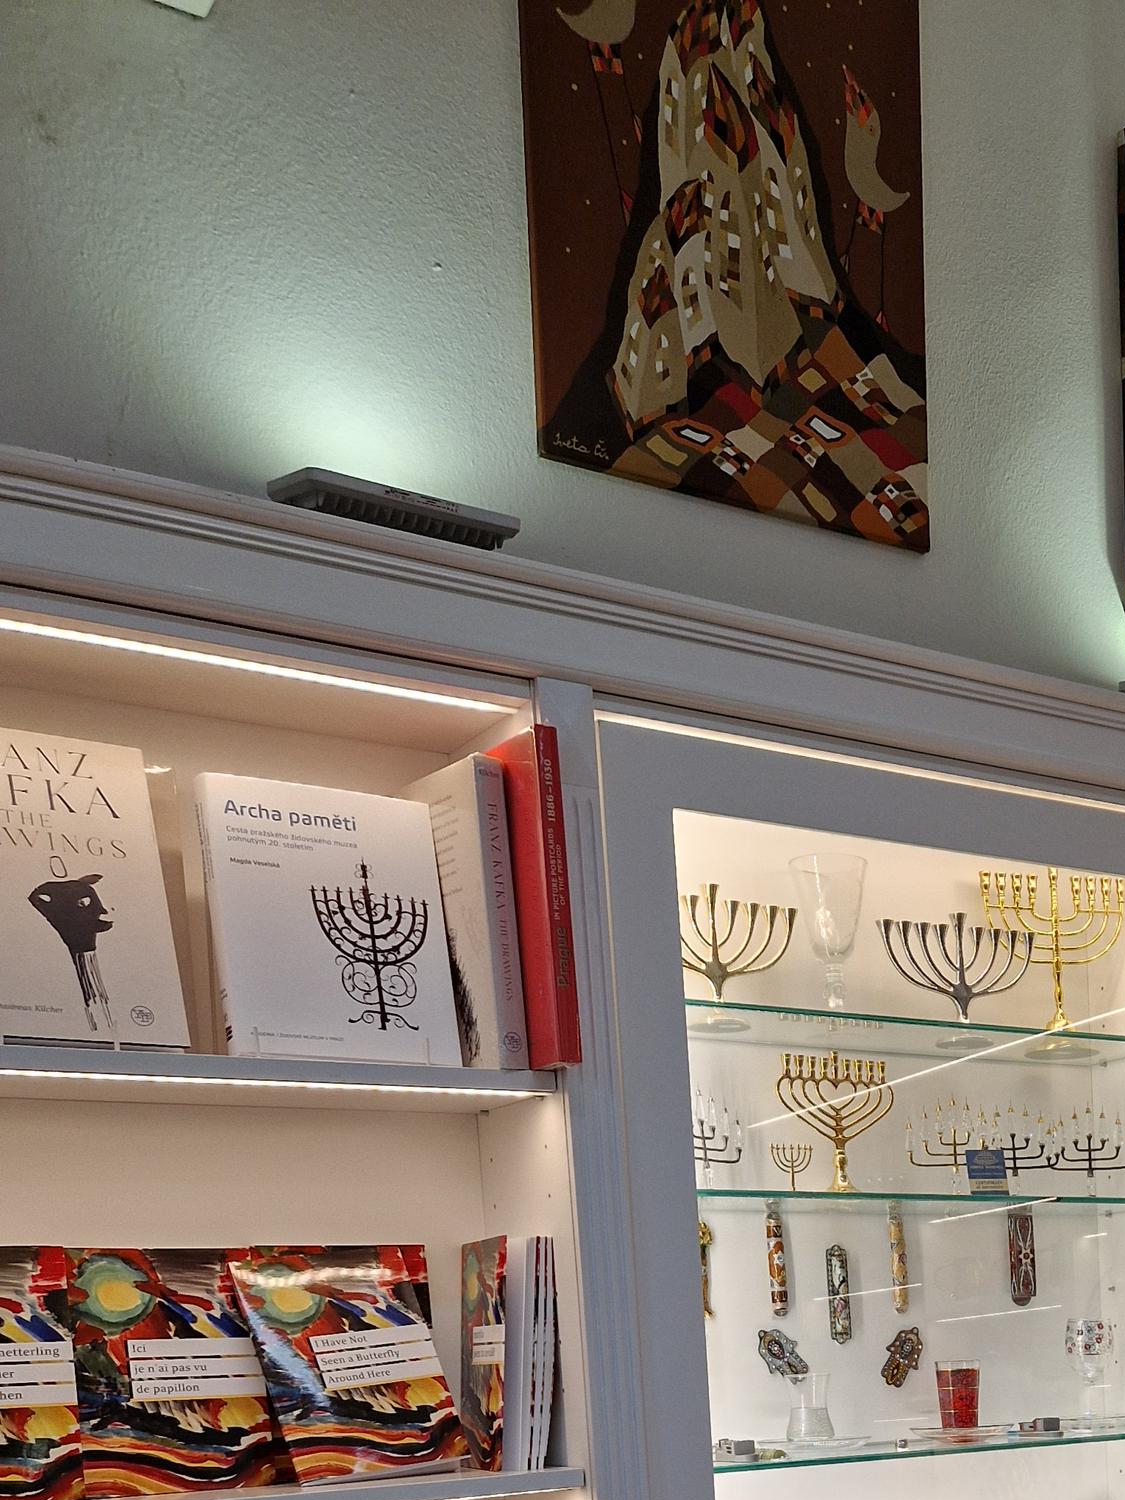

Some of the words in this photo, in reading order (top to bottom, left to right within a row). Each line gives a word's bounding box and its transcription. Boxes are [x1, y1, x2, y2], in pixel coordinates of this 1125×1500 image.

[0, 808, 52, 829] THE
[224, 799, 282, 822] Archa
[289, 811, 357, 832] paměti
[0, 826, 127, 860] WINGS
[555, 927, 570, 988] Prague
[132, 1344, 146, 1353] Ici
[322, 1337, 347, 1347] Have
[350, 1335, 367, 1345] Not
[321, 1356, 345, 1366] Seen
[356, 1349, 400, 1361] Butterfly
[134, 1365, 144, 1375] je
[171, 1364, 191, 1374] pas
[194, 1364, 207, 1372] vu
[328, 1371, 365, 1384] Around
[367, 1369, 391, 1380] Here
[136, 1385, 149, 1394] de
[153, 1384, 200, 1395] papillon
